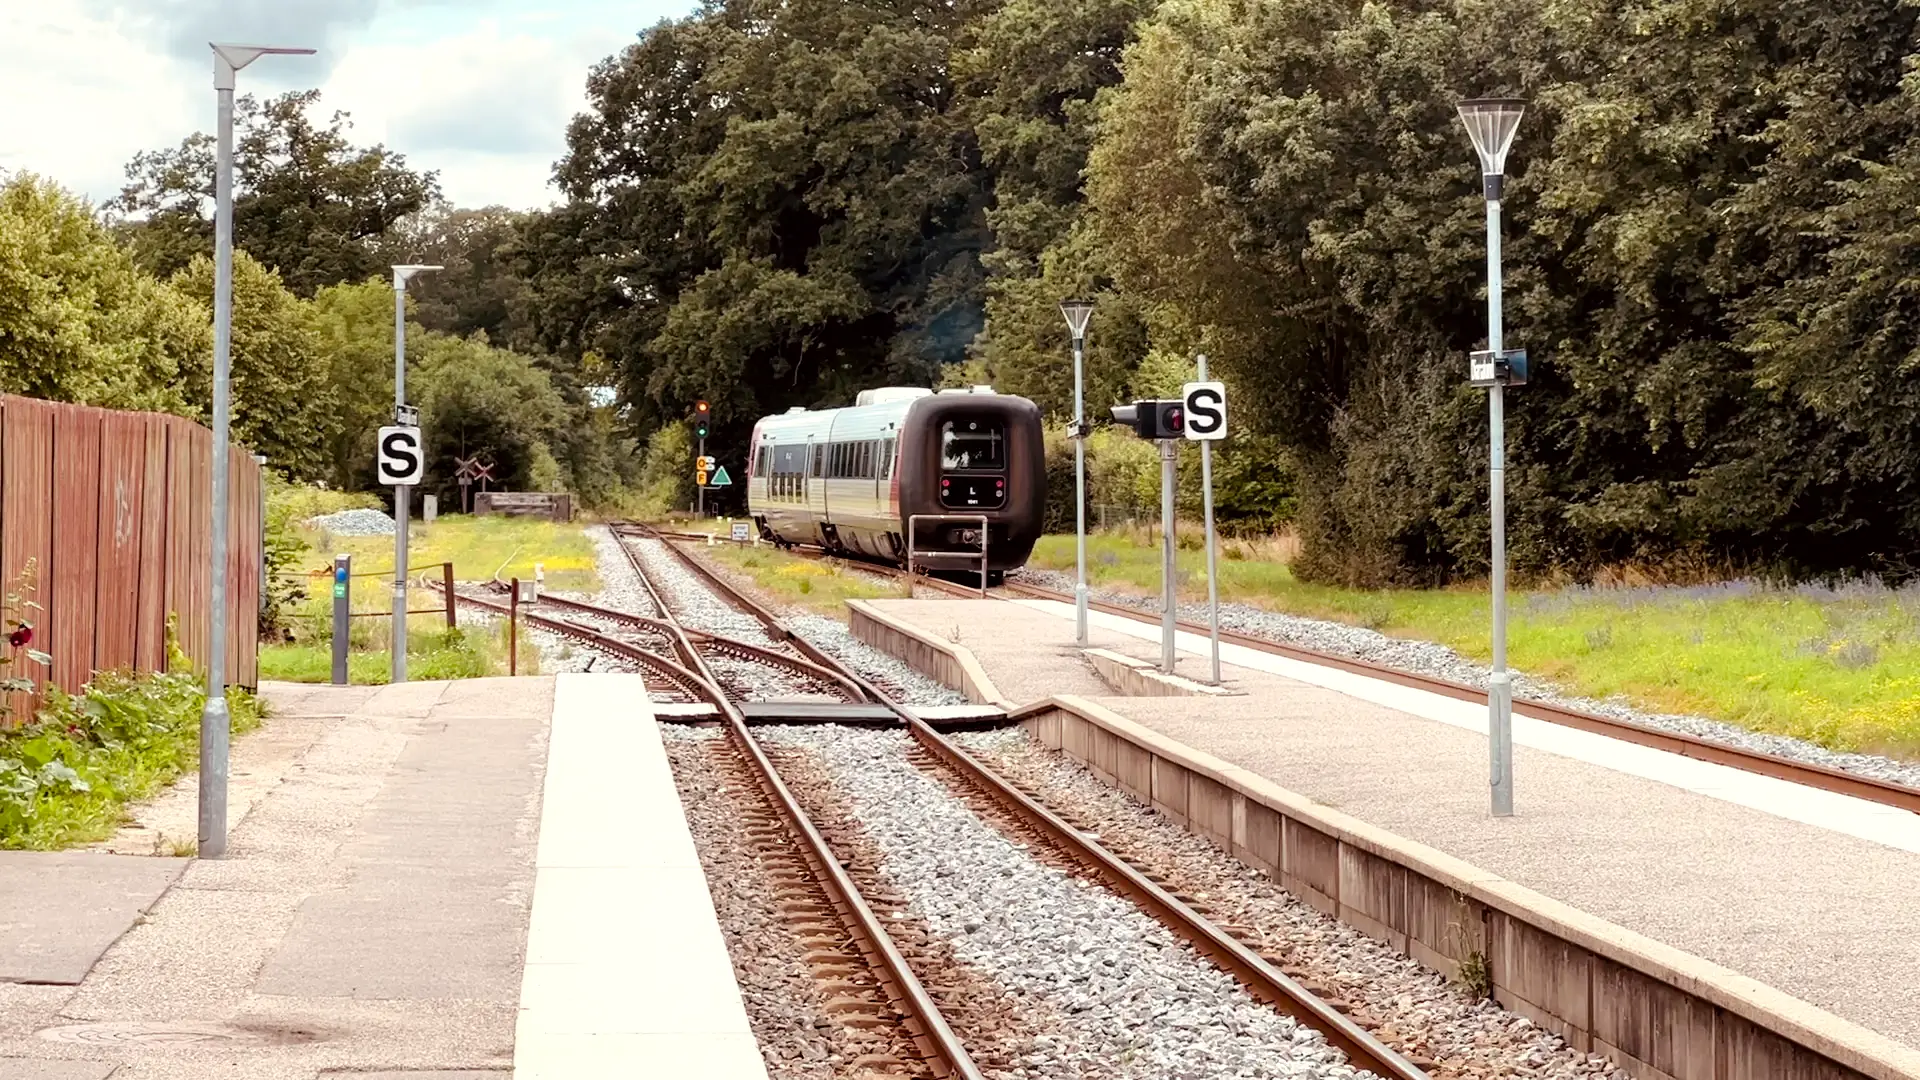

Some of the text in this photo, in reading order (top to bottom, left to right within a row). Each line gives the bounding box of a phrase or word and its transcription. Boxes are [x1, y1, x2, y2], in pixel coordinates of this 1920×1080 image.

[1187, 389, 1222, 433] S
[381, 433, 418, 478] S
[699, 474, 704, 482] F
[969, 487, 976, 495] L
